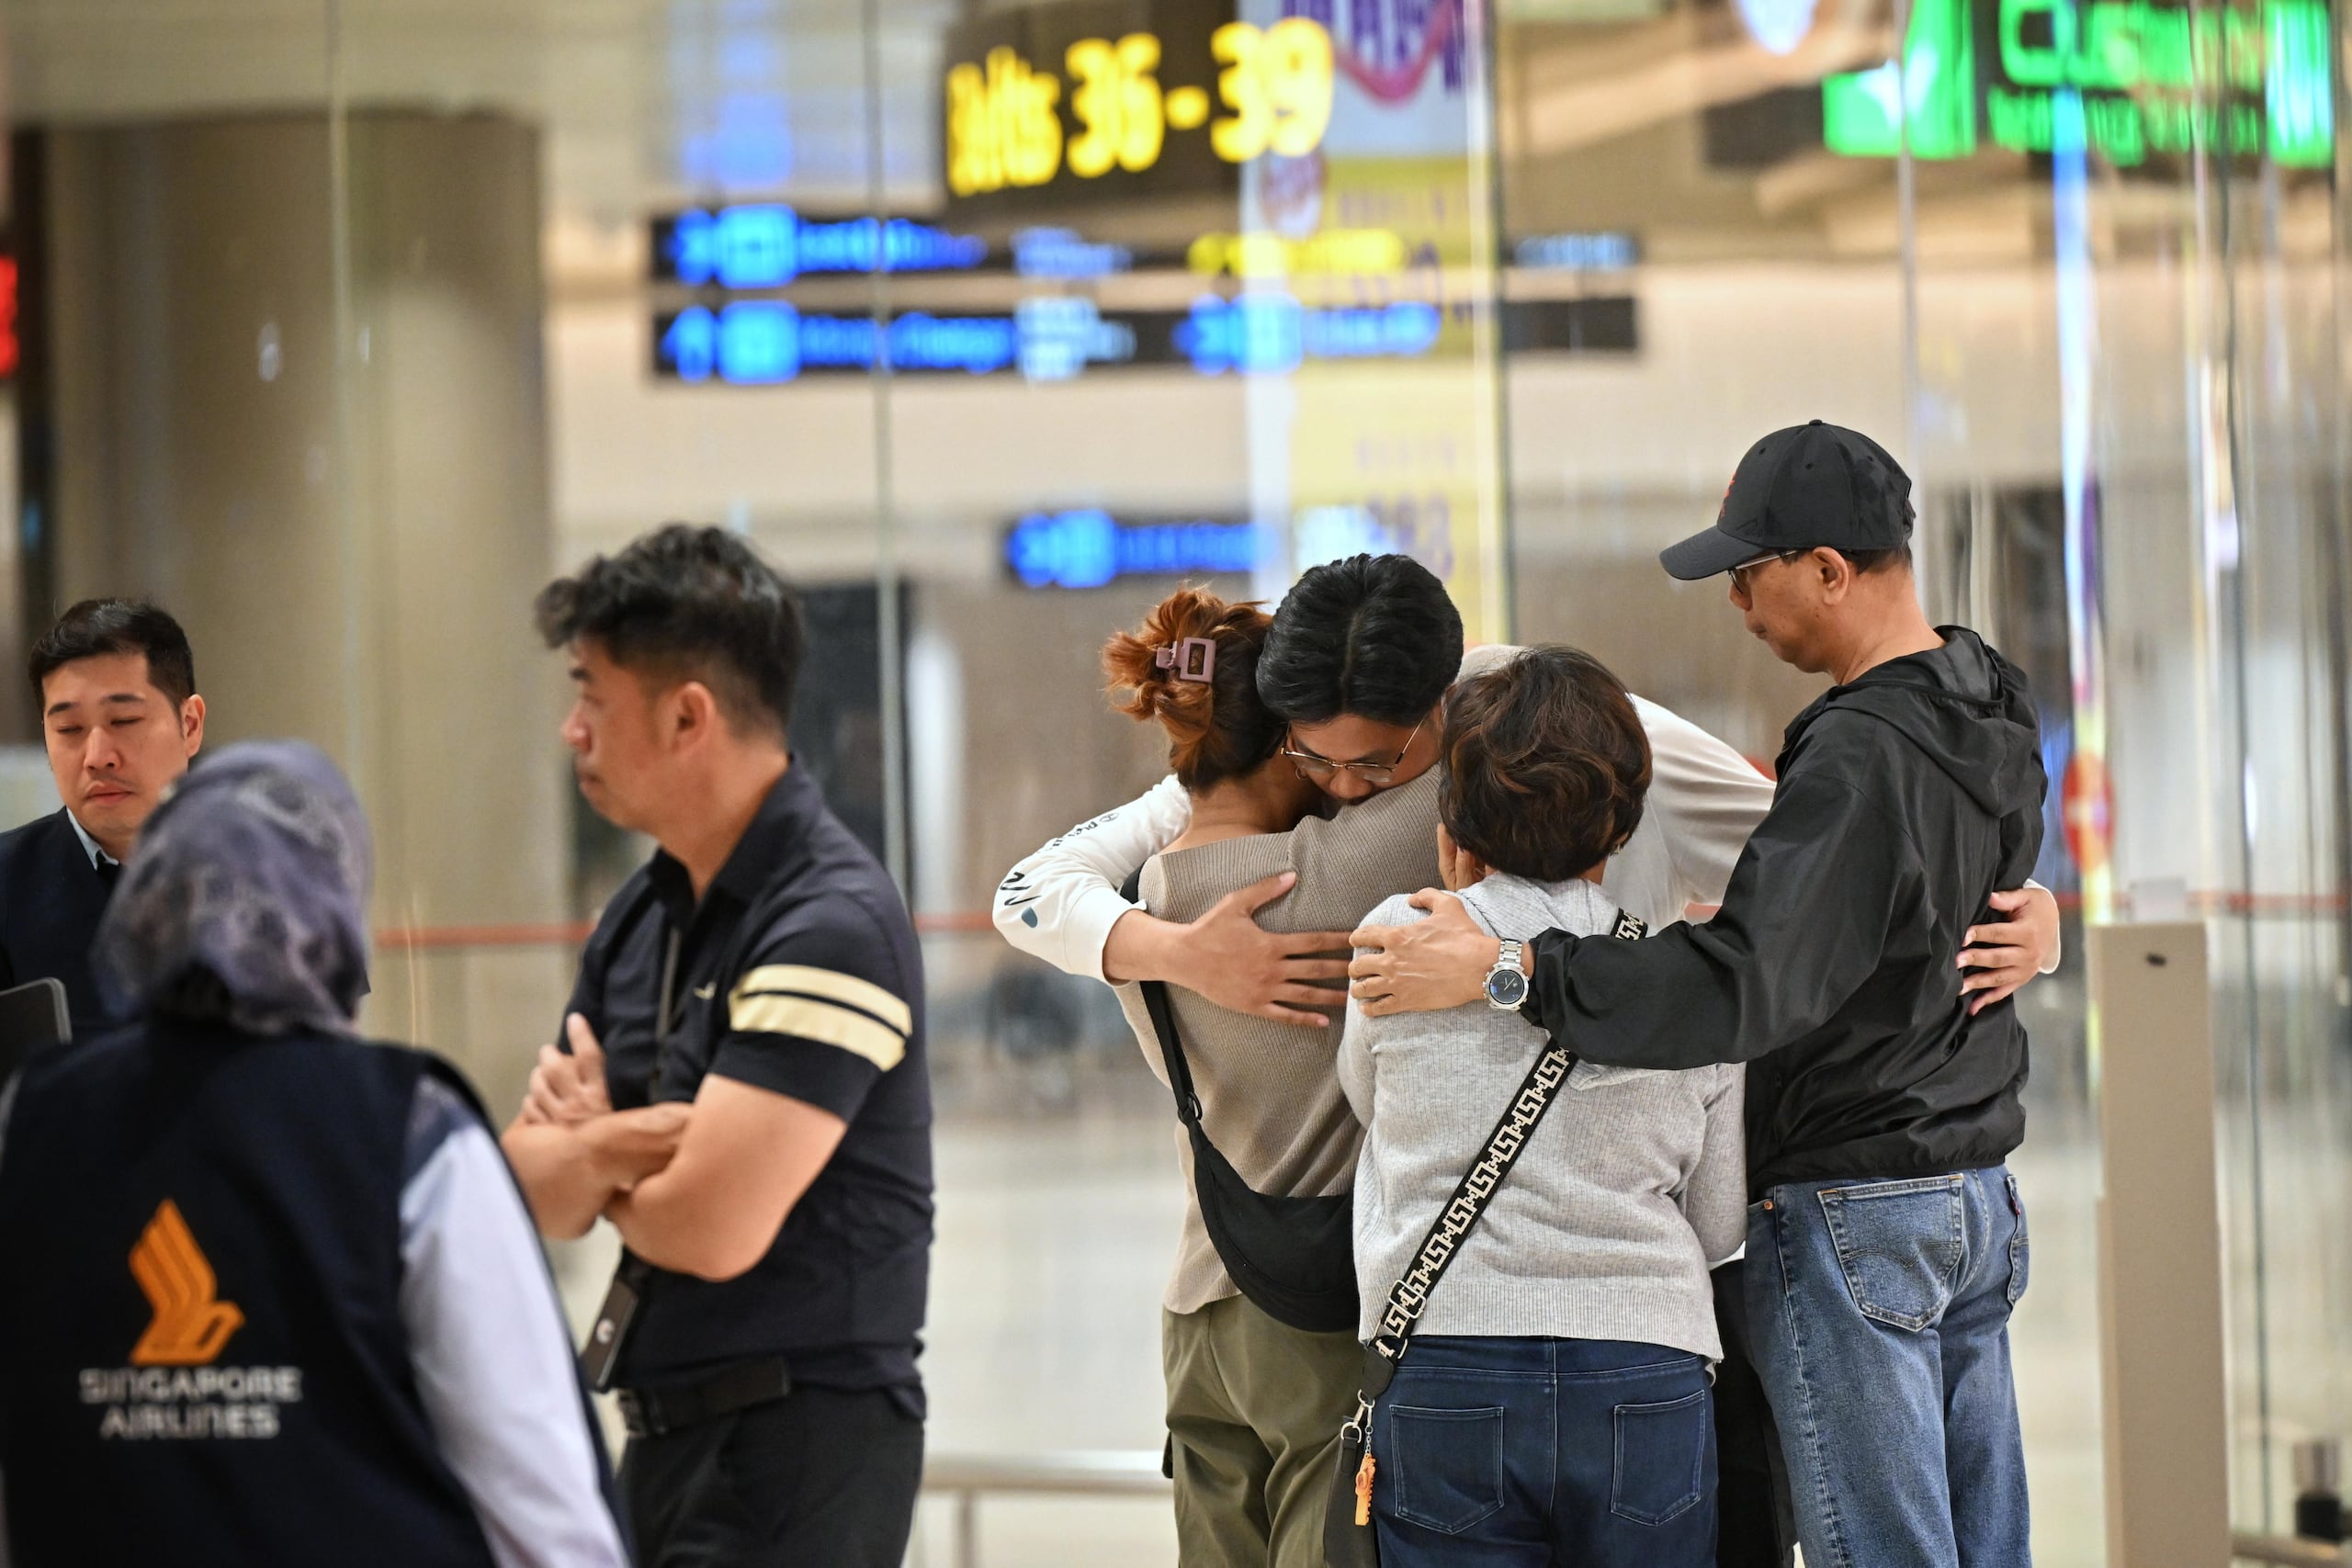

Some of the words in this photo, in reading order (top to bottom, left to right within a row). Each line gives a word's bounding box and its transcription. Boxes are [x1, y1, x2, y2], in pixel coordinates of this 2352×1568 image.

[1065, 32, 1165, 177] 36
[1210, 17, 1335, 162] 39
[79, 1367, 304, 1404] SINGAPORE
[100, 1405, 280, 1439] AIRLINES
